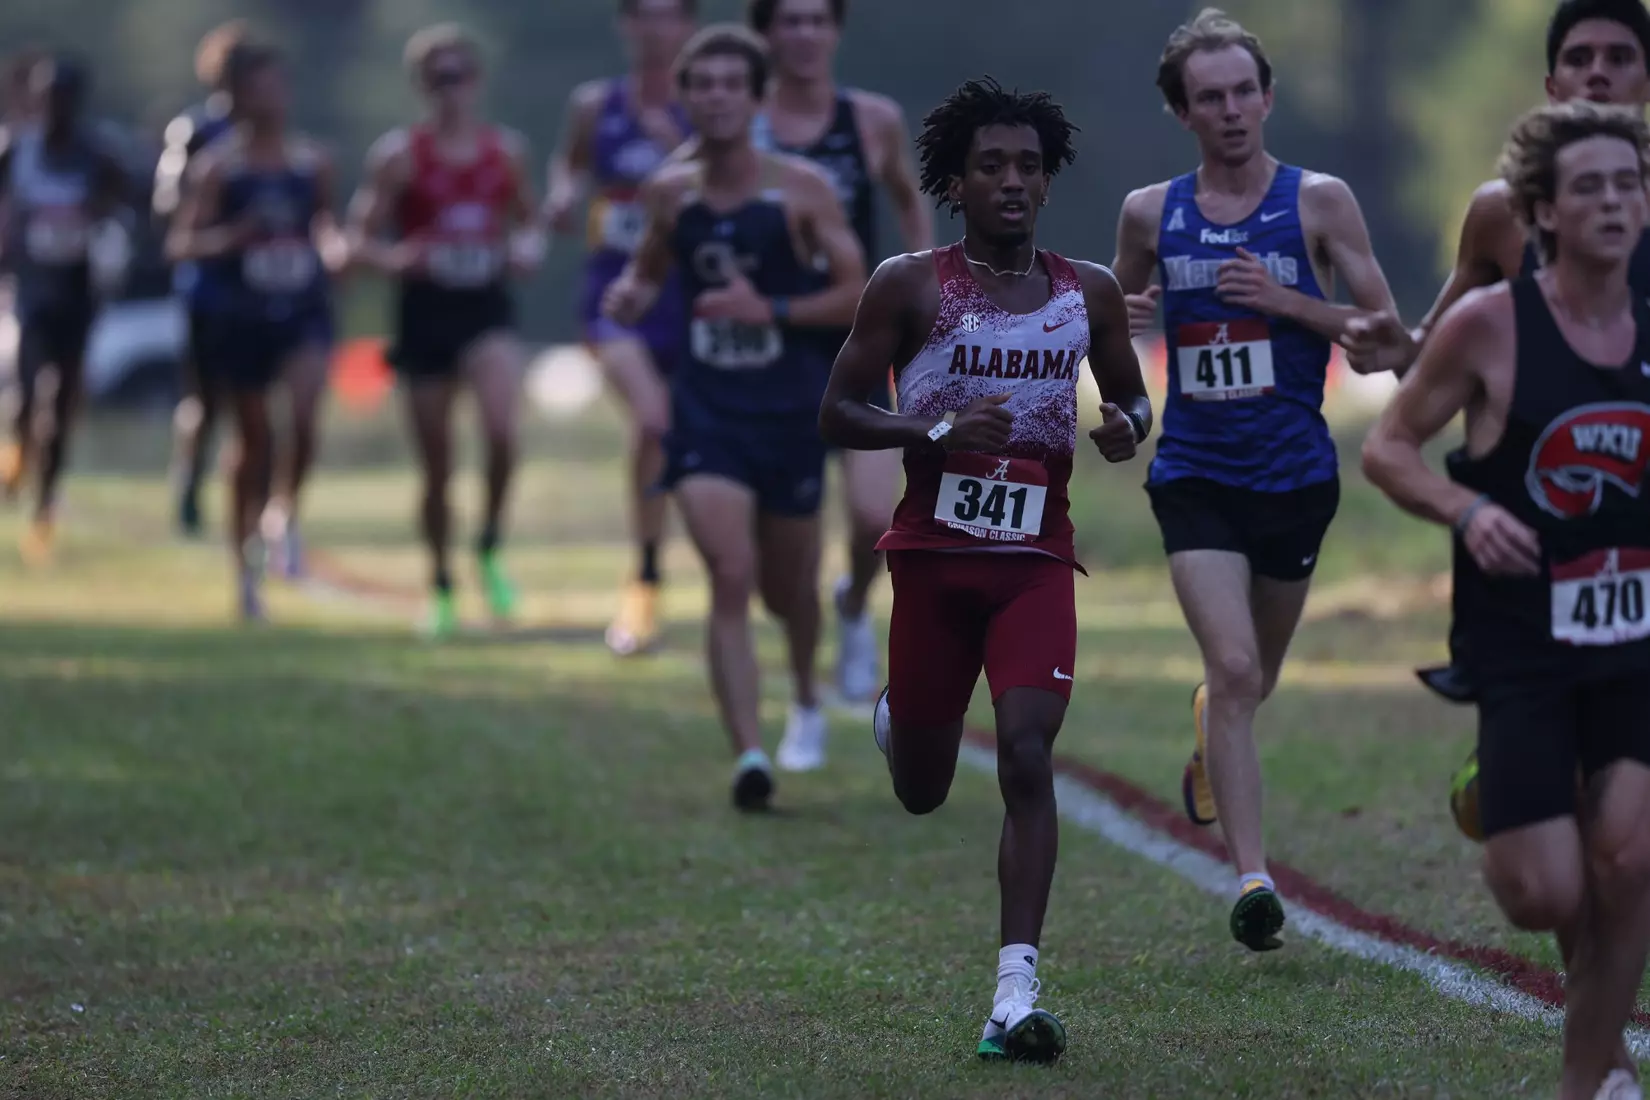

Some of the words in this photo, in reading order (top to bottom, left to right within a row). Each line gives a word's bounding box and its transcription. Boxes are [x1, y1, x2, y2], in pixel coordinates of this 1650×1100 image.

[1200, 228, 1249, 243] FedEx
[961, 314, 980, 332] SEC
[948, 344, 1077, 380] ALABAMA
[1196, 345, 1252, 388] 411
[1571, 424, 1642, 461] WKU
[985, 458, 1011, 480] A
[953, 478, 1028, 529] 341
[988, 529, 1027, 541] CLASSIC
[1571, 578, 1644, 628] 470
